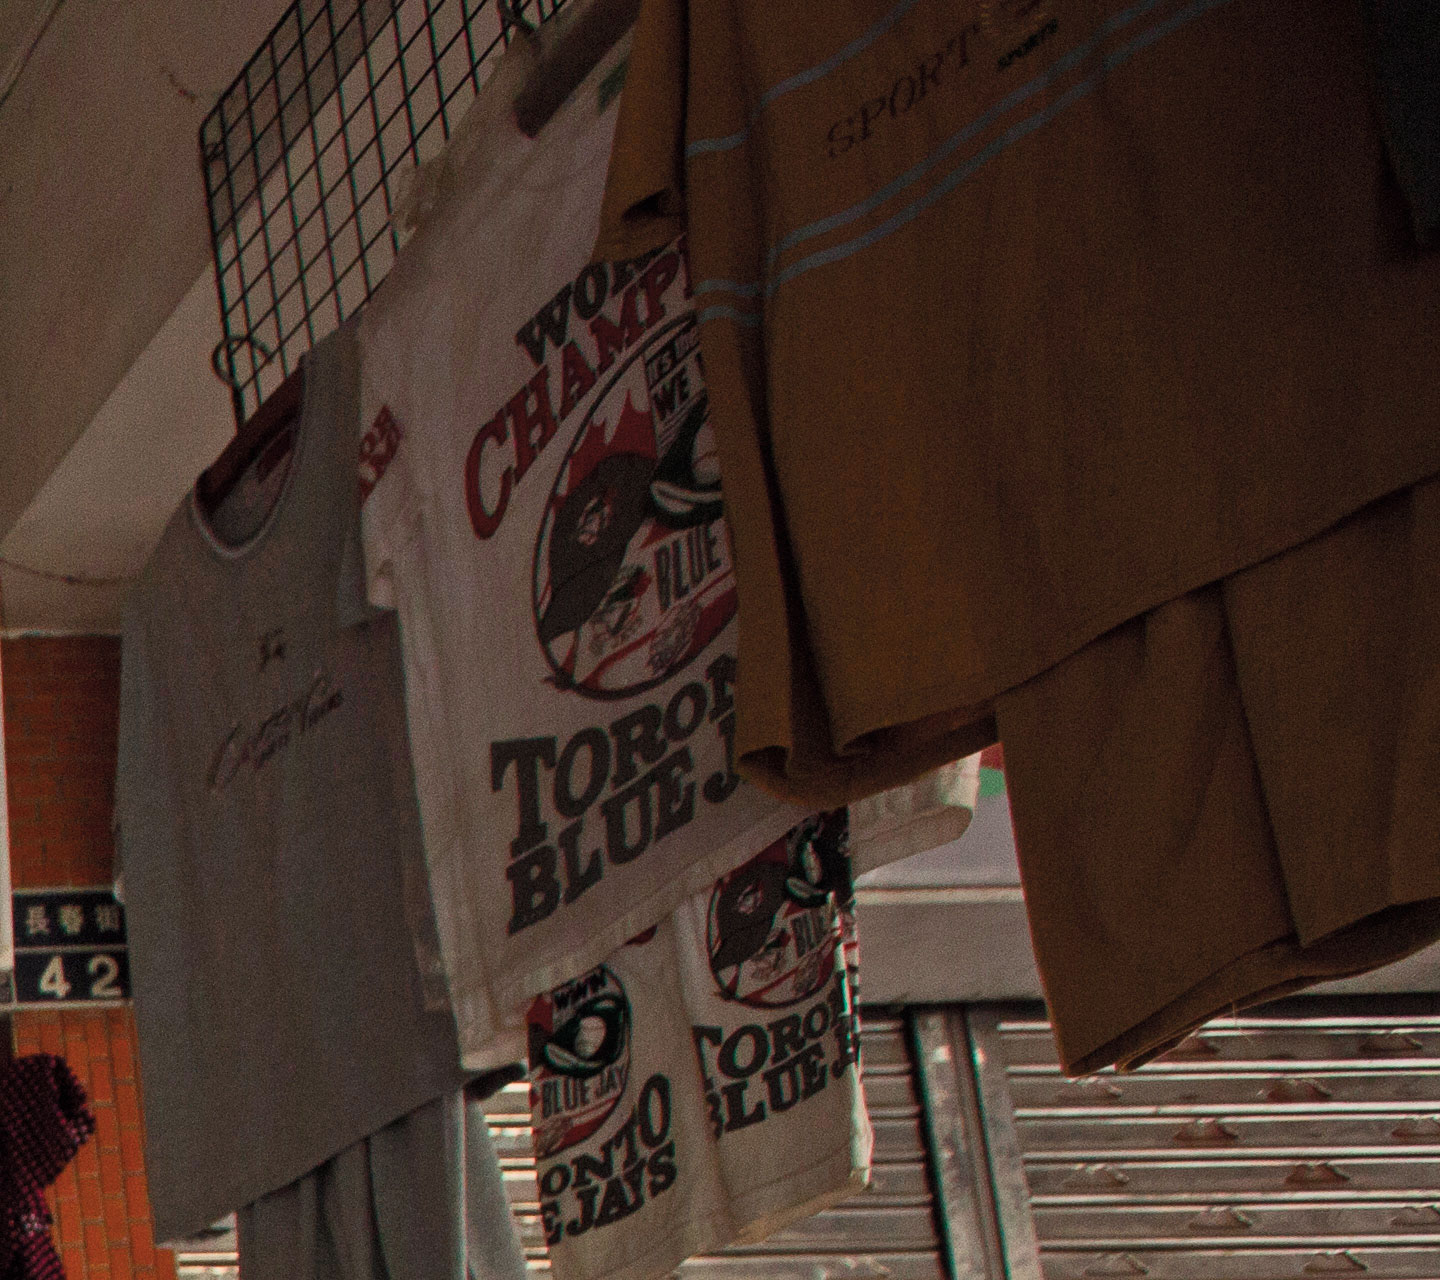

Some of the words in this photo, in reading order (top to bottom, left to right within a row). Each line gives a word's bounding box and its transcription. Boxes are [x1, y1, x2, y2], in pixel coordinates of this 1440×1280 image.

[515, 246, 676, 366] WOR
[506, 750, 696, 936] BLUE
[40, 954, 122, 997] 42
